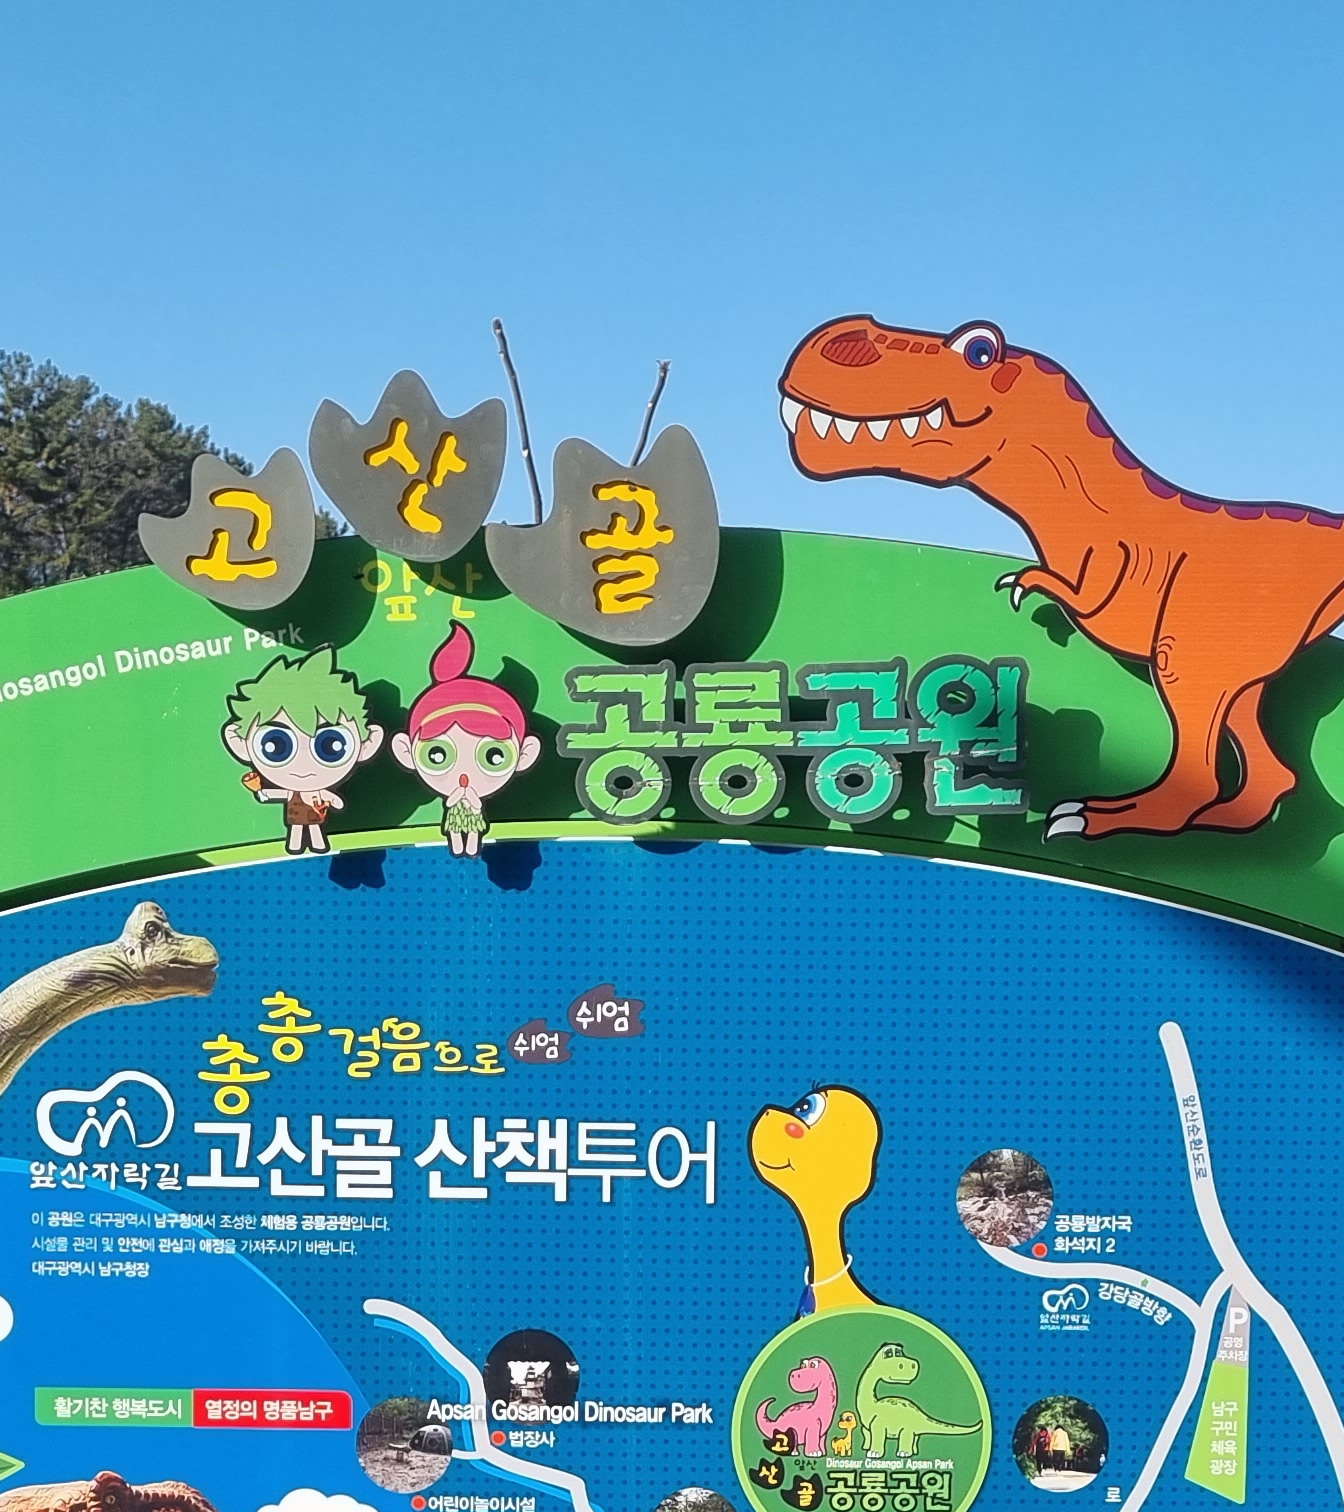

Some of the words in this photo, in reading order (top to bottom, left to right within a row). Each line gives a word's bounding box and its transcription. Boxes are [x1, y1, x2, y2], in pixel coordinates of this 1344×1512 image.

[360, 558, 481, 622] 앞산
[114, 634, 233, 675] Dinosaur
[243, 622, 304, 650] Park
[559, 656, 1030, 824] 공룡공원
[329, 1015, 506, 1078] 걸음으로
[514, 1031, 561, 1060] 쉬엄
[576, 1000, 630, 1034] 쉬엄
[1182, 1095, 1207, 1180] 앞산순환도로
[186, 1115, 400, 1200] 고산골
[414, 1118, 716, 1204] 산책투어
[30, 1160, 181, 1192] 앞산자락길
[31, 1212, 44, 1226] 이
[48, 1211, 85, 1228] 공원은
[89, 1212, 151, 1228] 대구광역시
[154, 1213, 215, 1229] 남구청에서
[219, 1214, 257, 1230] 조성한
[260, 1214, 298, 1230] 체험용
[301, 1215, 391, 1231] 공룡공원입니다.
[1054, 1215, 1132, 1233] 공룡발자국
[31, 1236, 68, 1252] 시설물
[72, 1237, 98, 1252] 관리
[102, 1237, 114, 1252] 및
[117, 1237, 155, 1253] 안전에
[158, 1238, 196, 1253] 관심과
[199, 1238, 236, 1254] 애정을
[240, 1239, 302, 1255] 가져주시기
[306, 1240, 358, 1256] 바랍니다.
[1054, 1237, 1101, 1254] 화석지
[1105, 1239, 1116, 1253] 2
[31, 1261, 95, 1277] 대구광역시
[98, 1261, 150, 1278] 남구청장
[1098, 1282, 1172, 1326] 강당골방향
[1229, 1307, 1248, 1333] P
[1222, 1335, 1244, 1349] 공영
[1217, 1349, 1248, 1362] 주차장
[54, 1396, 109, 1419] 활기찬
[112, 1397, 182, 1420] 행복도시
[205, 1398, 258, 1420] 열정의
[263, 1399, 334, 1422] 명품남구
[426, 1399, 486, 1423] Apsan
[492, 1400, 579, 1424] Gosangol
[584, 1401, 666, 1424] Dinosaur
[671, 1402, 713, 1425] Park
[1211, 1401, 1239, 1418] 남구
[508, 1430, 556, 1448] 법장사
[1210, 1421, 1237, 1437] 구민
[1210, 1440, 1237, 1456] 체육
[826, 1458, 863, 1468] Dinosaur
[865, 1458, 903, 1470] Gosangol
[906, 1459, 932, 1470] Apsan
[935, 1459, 954, 1469] Park
[1209, 1459, 1236, 1476] 광장
[825, 1470, 952, 1512] 공룡공원
